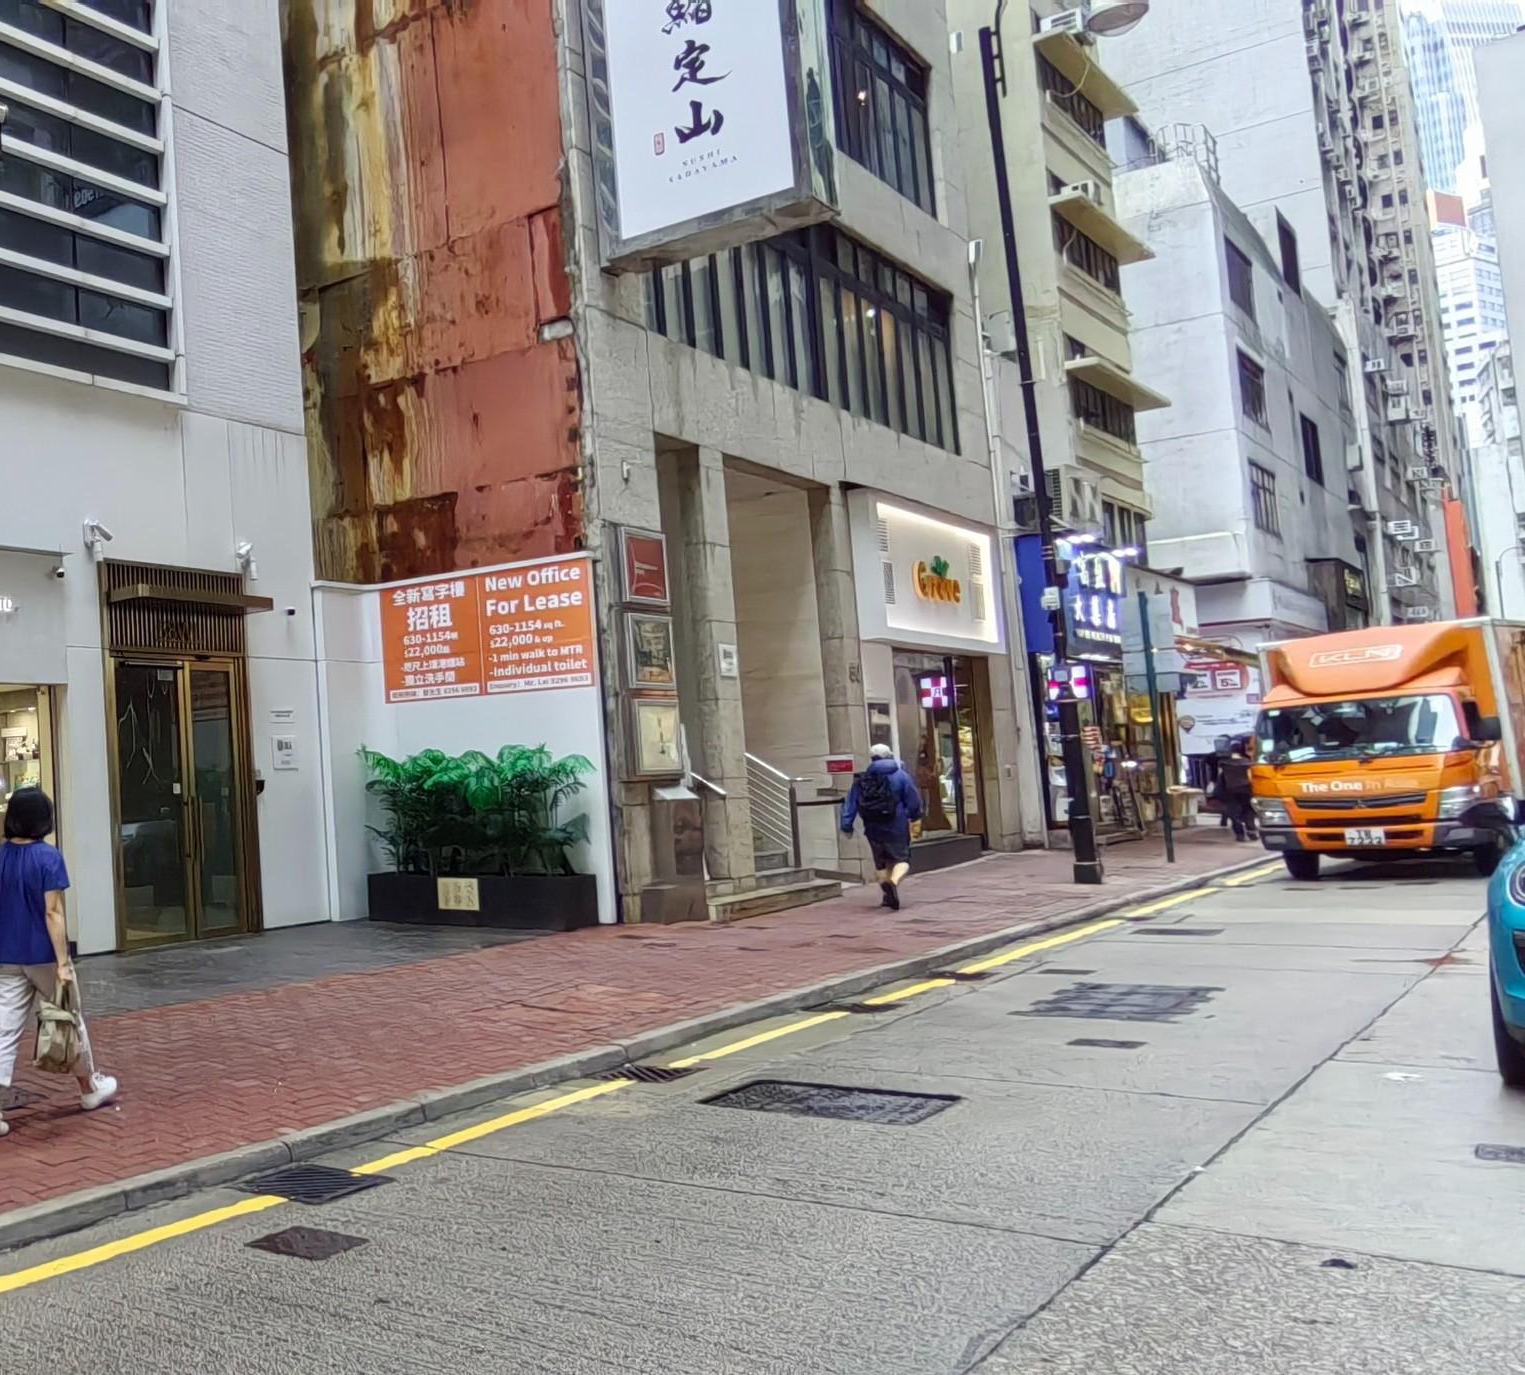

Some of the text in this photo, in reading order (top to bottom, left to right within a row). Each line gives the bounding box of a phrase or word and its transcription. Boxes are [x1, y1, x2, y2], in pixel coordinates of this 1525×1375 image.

[484, 566, 581, 592] New Office
[485, 591, 583, 617] For Lease
[407, 603, 453, 631] 招租
[489, 619, 542, 635] 630-1154
[500, 651, 519, 661] min
[521, 648, 545, 660] walk
[547, 648, 558, 657] to
[560, 645, 583, 655] MTR
[489, 658, 588, 677] -Individual toilet
[1301, 782, 1329, 793] The
[1330, 780, 1365, 792] One
